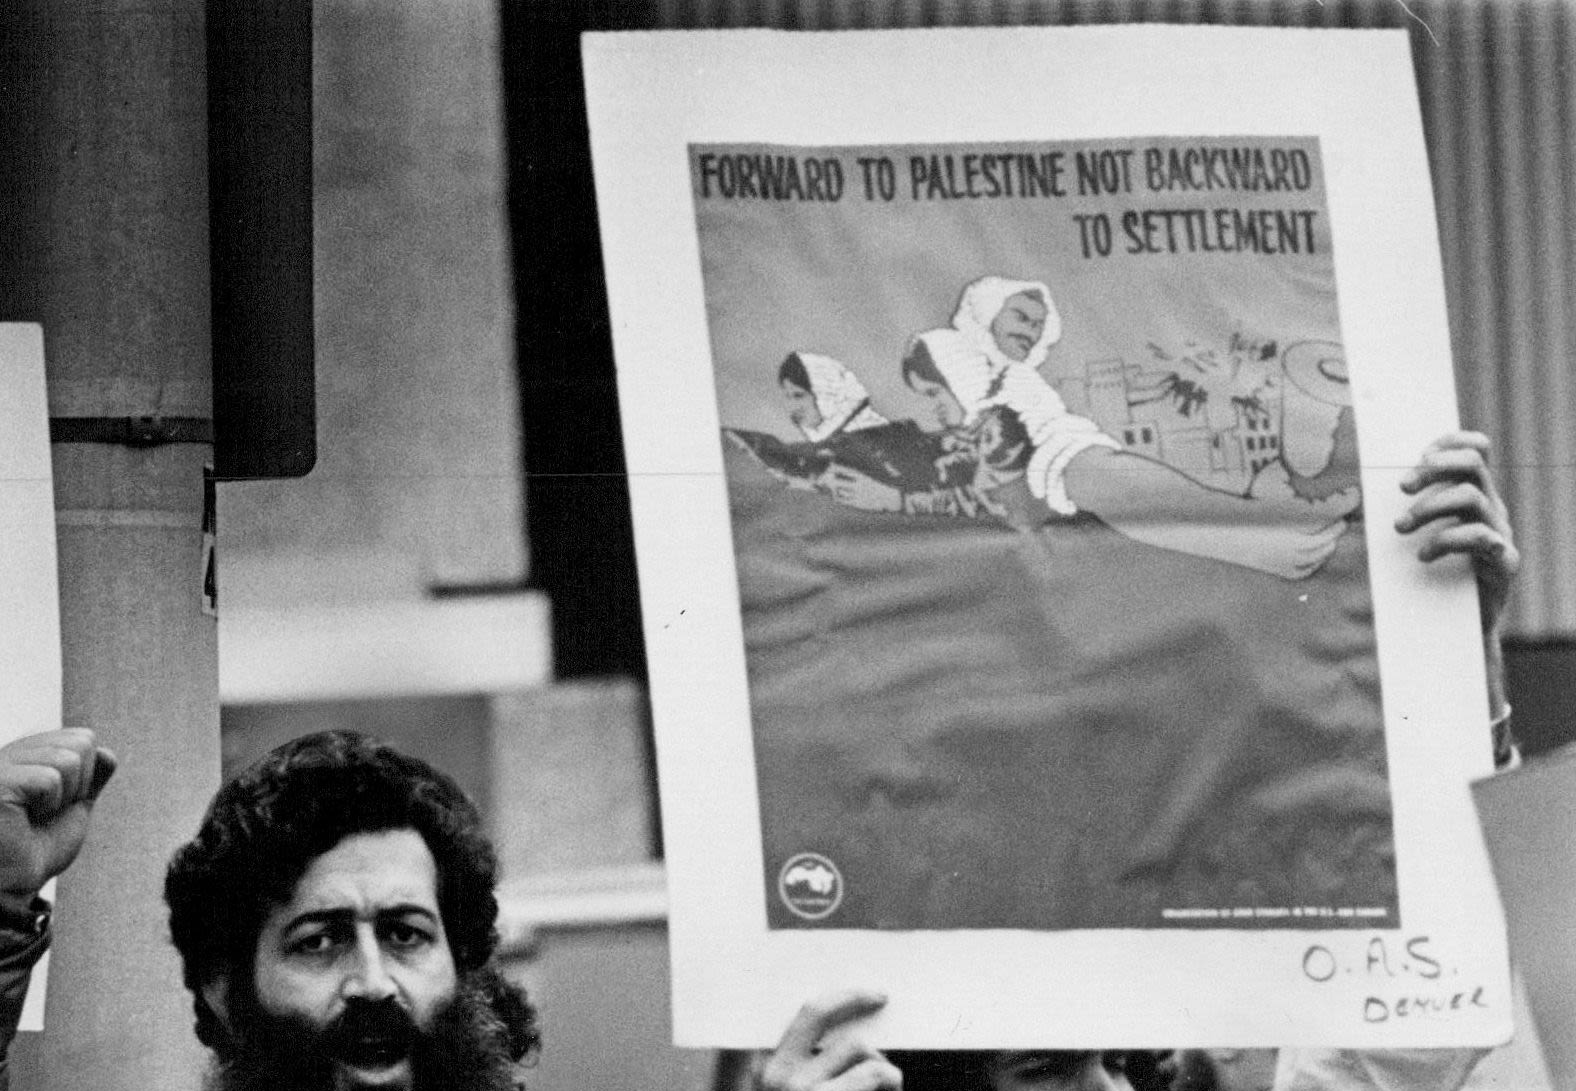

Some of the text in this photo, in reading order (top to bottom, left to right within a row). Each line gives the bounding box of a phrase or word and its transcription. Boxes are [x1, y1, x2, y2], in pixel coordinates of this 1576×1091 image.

[699, 146, 1312, 202] FORWARD TO PALESTINE NOT BACKWARD
[1073, 207, 1317, 259] TO SETTLEMENT
